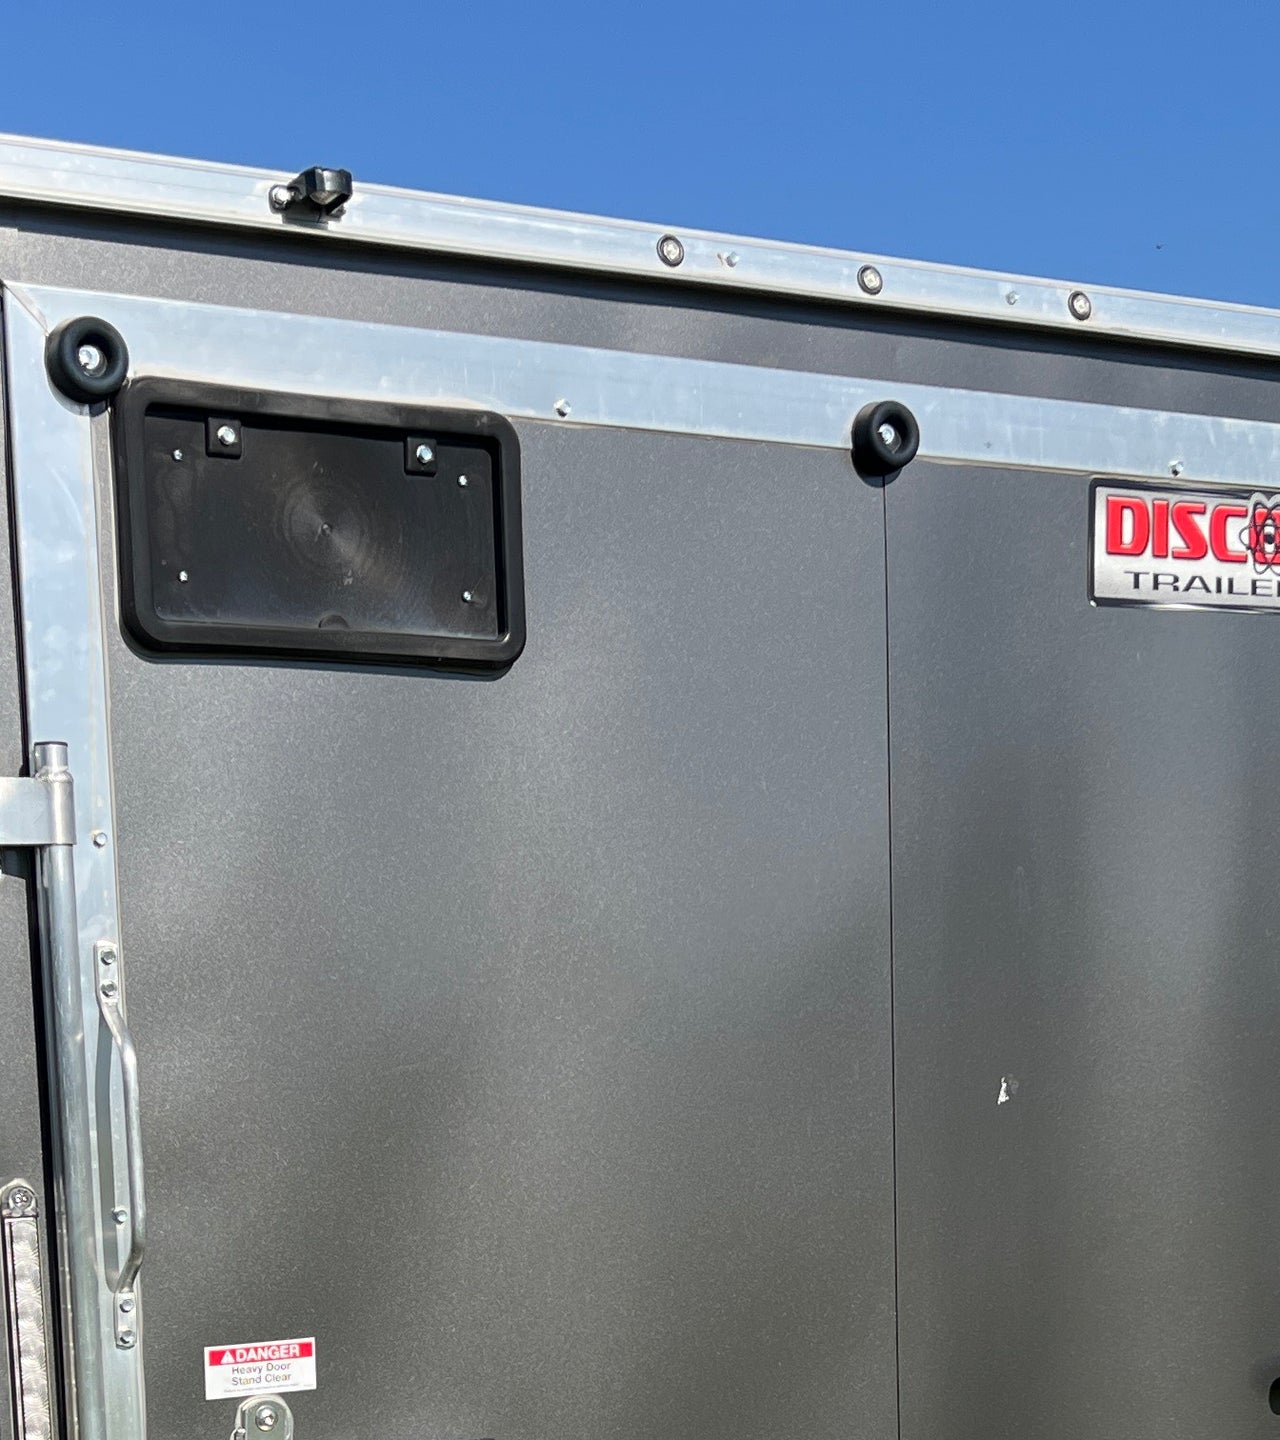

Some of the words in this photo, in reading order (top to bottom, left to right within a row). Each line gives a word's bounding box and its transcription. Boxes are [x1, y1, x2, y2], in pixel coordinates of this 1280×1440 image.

[236, 1344, 300, 1362] DANGER
[231, 1364, 263, 1375] Heavy
[266, 1362, 292, 1371] Door
[231, 1375, 262, 1386] Stand
[265, 1373, 292, 1383] Clear
